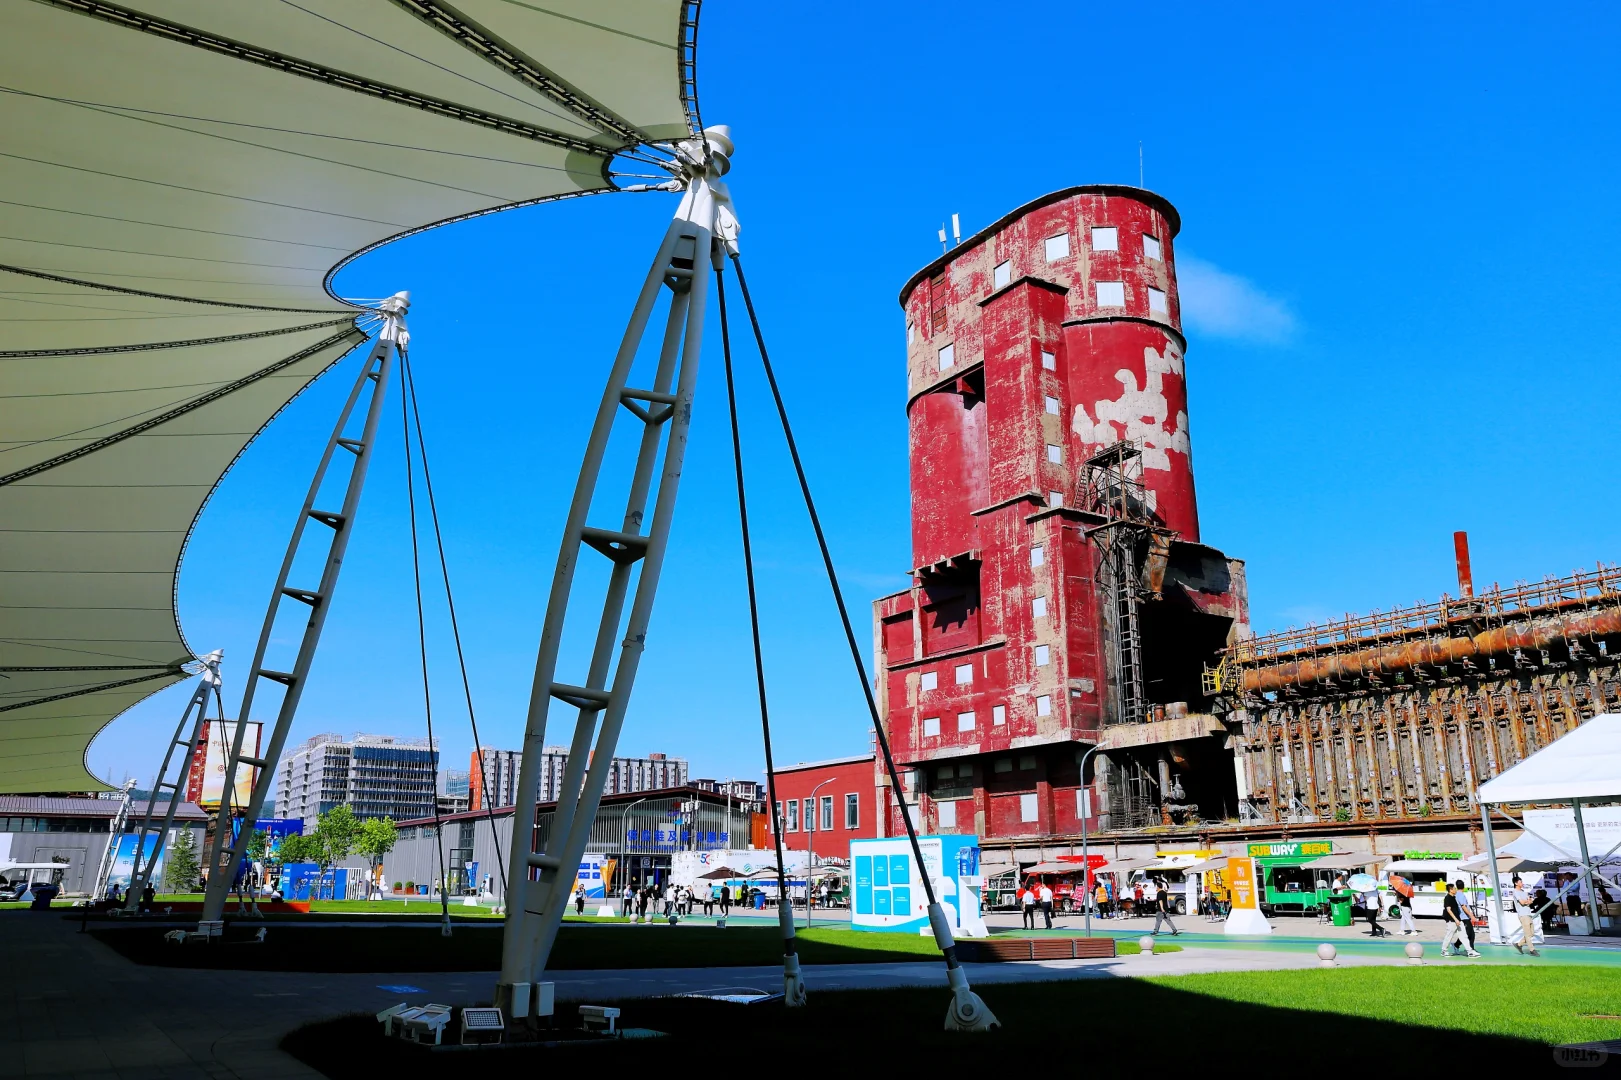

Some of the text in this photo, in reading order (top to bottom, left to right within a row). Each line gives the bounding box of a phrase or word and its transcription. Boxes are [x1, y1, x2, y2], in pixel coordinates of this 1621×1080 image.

[1248, 843, 1331, 857] SUBWAY 赛百味
